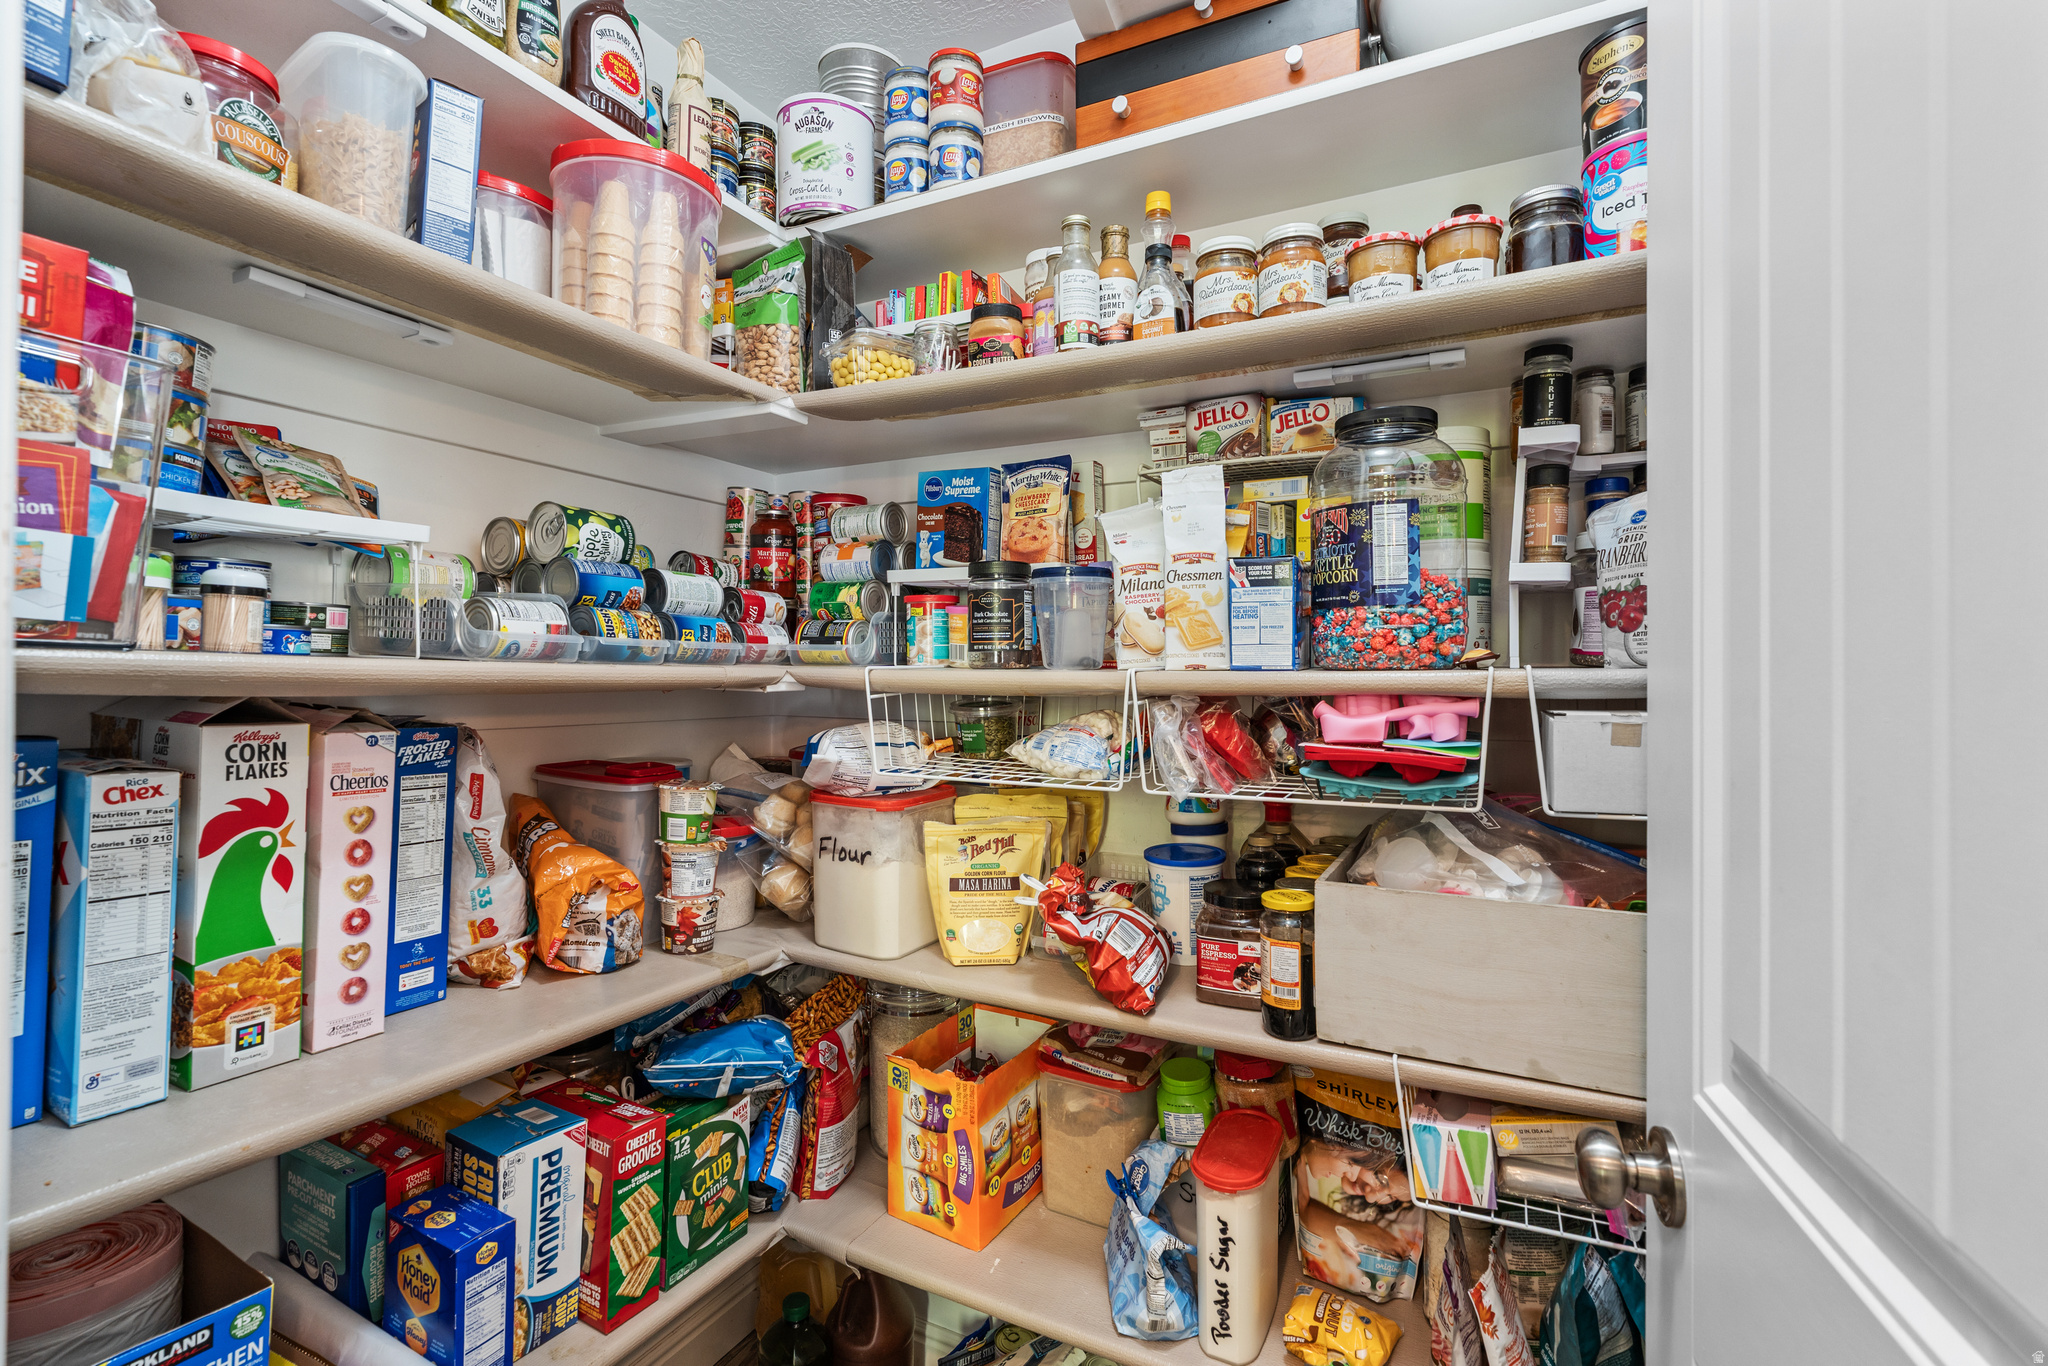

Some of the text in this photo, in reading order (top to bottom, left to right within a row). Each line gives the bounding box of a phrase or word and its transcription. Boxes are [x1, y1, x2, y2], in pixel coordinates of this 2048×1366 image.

[470, 4, 496, 26] HEINZ
[526, 12, 555, 31] Mustard
[596, 28, 615, 39] SWEET
[616, 31, 631, 47] BABY
[1591, 39, 1635, 70] Stephen's
[608, 54, 630, 73] Sweet
[614, 65, 632, 84] Spicy
[961, 79, 977, 91] Lay's
[891, 93, 909, 106] Lay's
[461, 112, 475, 122] 200
[794, 115, 834, 132] AUGASON
[989, 114, 1062, 132] HASH BROWNS
[215, 120, 286, 166] COUSCOUS
[889, 165, 907, 179] Lay's
[789, 184, 818, 196] Cross-Cut
[1593, 177, 1616, 194] Great
[1599, 185, 1617, 197] Value
[1602, 196, 1636, 219] Iced
[1207, 275, 1232, 290] Mrs.
[1260, 268, 1280, 287] Mrs.
[1100, 293, 1121, 302] REAMY
[1199, 282, 1252, 300] Richardson's
[1064, 325, 1077, 333] NO
[1142, 326, 1163, 335] COCONUT
[973, 356, 1014, 367] COOKIE BUTTER
[1197, 400, 1221, 411] chocolate
[1194, 401, 1249, 431] JELL-O
[1275, 403, 1330, 434] JELL-O
[160, 471, 191, 484] CHICKEN
[951, 476, 974, 487] Moist
[1010, 470, 1062, 493] Martha White
[925, 483, 943, 493] Pillsbury
[944, 486, 981, 497] Supreme
[1015, 493, 1051, 503] STRAWBERRY
[1015, 499, 1049, 508] CHEESECAKE
[917, 513, 943, 521] Chocolate
[1618, 533, 1644, 545] DRIED
[757, 549, 789, 558] Marinara
[1314, 554, 1354, 572] KETTLE
[1166, 570, 1222, 583] Chessmen
[1313, 568, 1358, 586] POPCORN
[1118, 578, 1164, 596] Milano
[154, 733, 170, 747] CORN
[233, 730, 281, 746] Kellogg's
[413, 732, 439, 741] Kellogg's
[153, 745, 169, 757] FLAKES
[225, 742, 287, 764] CORN
[397, 740, 450, 758] FROSTED
[400, 750, 445, 767] FLAKES
[225, 760, 288, 782] FLAKES
[126, 778, 149, 787] Rice
[330, 775, 388, 791] Cheerios
[103, 784, 164, 805] Chex
[92, 811, 140, 819] Nutrition
[91, 834, 173, 849] Calories 150 210
[970, 839, 992, 861] Red
[992, 834, 1014, 855] Mill
[818, 836, 872, 866] Flour
[958, 879, 1012, 891] MASA HARINA
[477, 886, 493, 909] 33
[1201, 943, 1220, 951] PURE
[1201, 950, 1237, 960] ESPRESSO
[892, 1066, 902, 1088] 30
[732, 1100, 749, 1119] NEW
[416, 1118, 435, 1136] 100%
[1304, 1108, 1363, 1140] Whisk
[674, 1135, 691, 1154] 12
[618, 1139, 662, 1174] GROOVES
[674, 1149, 691, 1161] PACKS
[946, 1155, 953, 1165] 12
[958, 1145, 966, 1170] SMILES
[406, 1168, 430, 1183] TOWN
[693, 1151, 732, 1196] CLUB
[1013, 1161, 1041, 1195] BIG SMILES
[288, 1171, 336, 1206] PARCHMENT
[406, 1175, 431, 1191] HOUSE
[700, 1175, 728, 1205] minis
[990, 1179, 1000, 1192] 10
[312, 1197, 336, 1219] SHEETS
[537, 1147, 563, 1284] PREMIUM
[401, 1255, 438, 1294] Honey
[403, 1275, 430, 1306] Maid
[555, 1293, 566, 1327] SOUP
[567, 1287, 579, 1325] FREE
[234, 1311, 263, 1328] 15%
